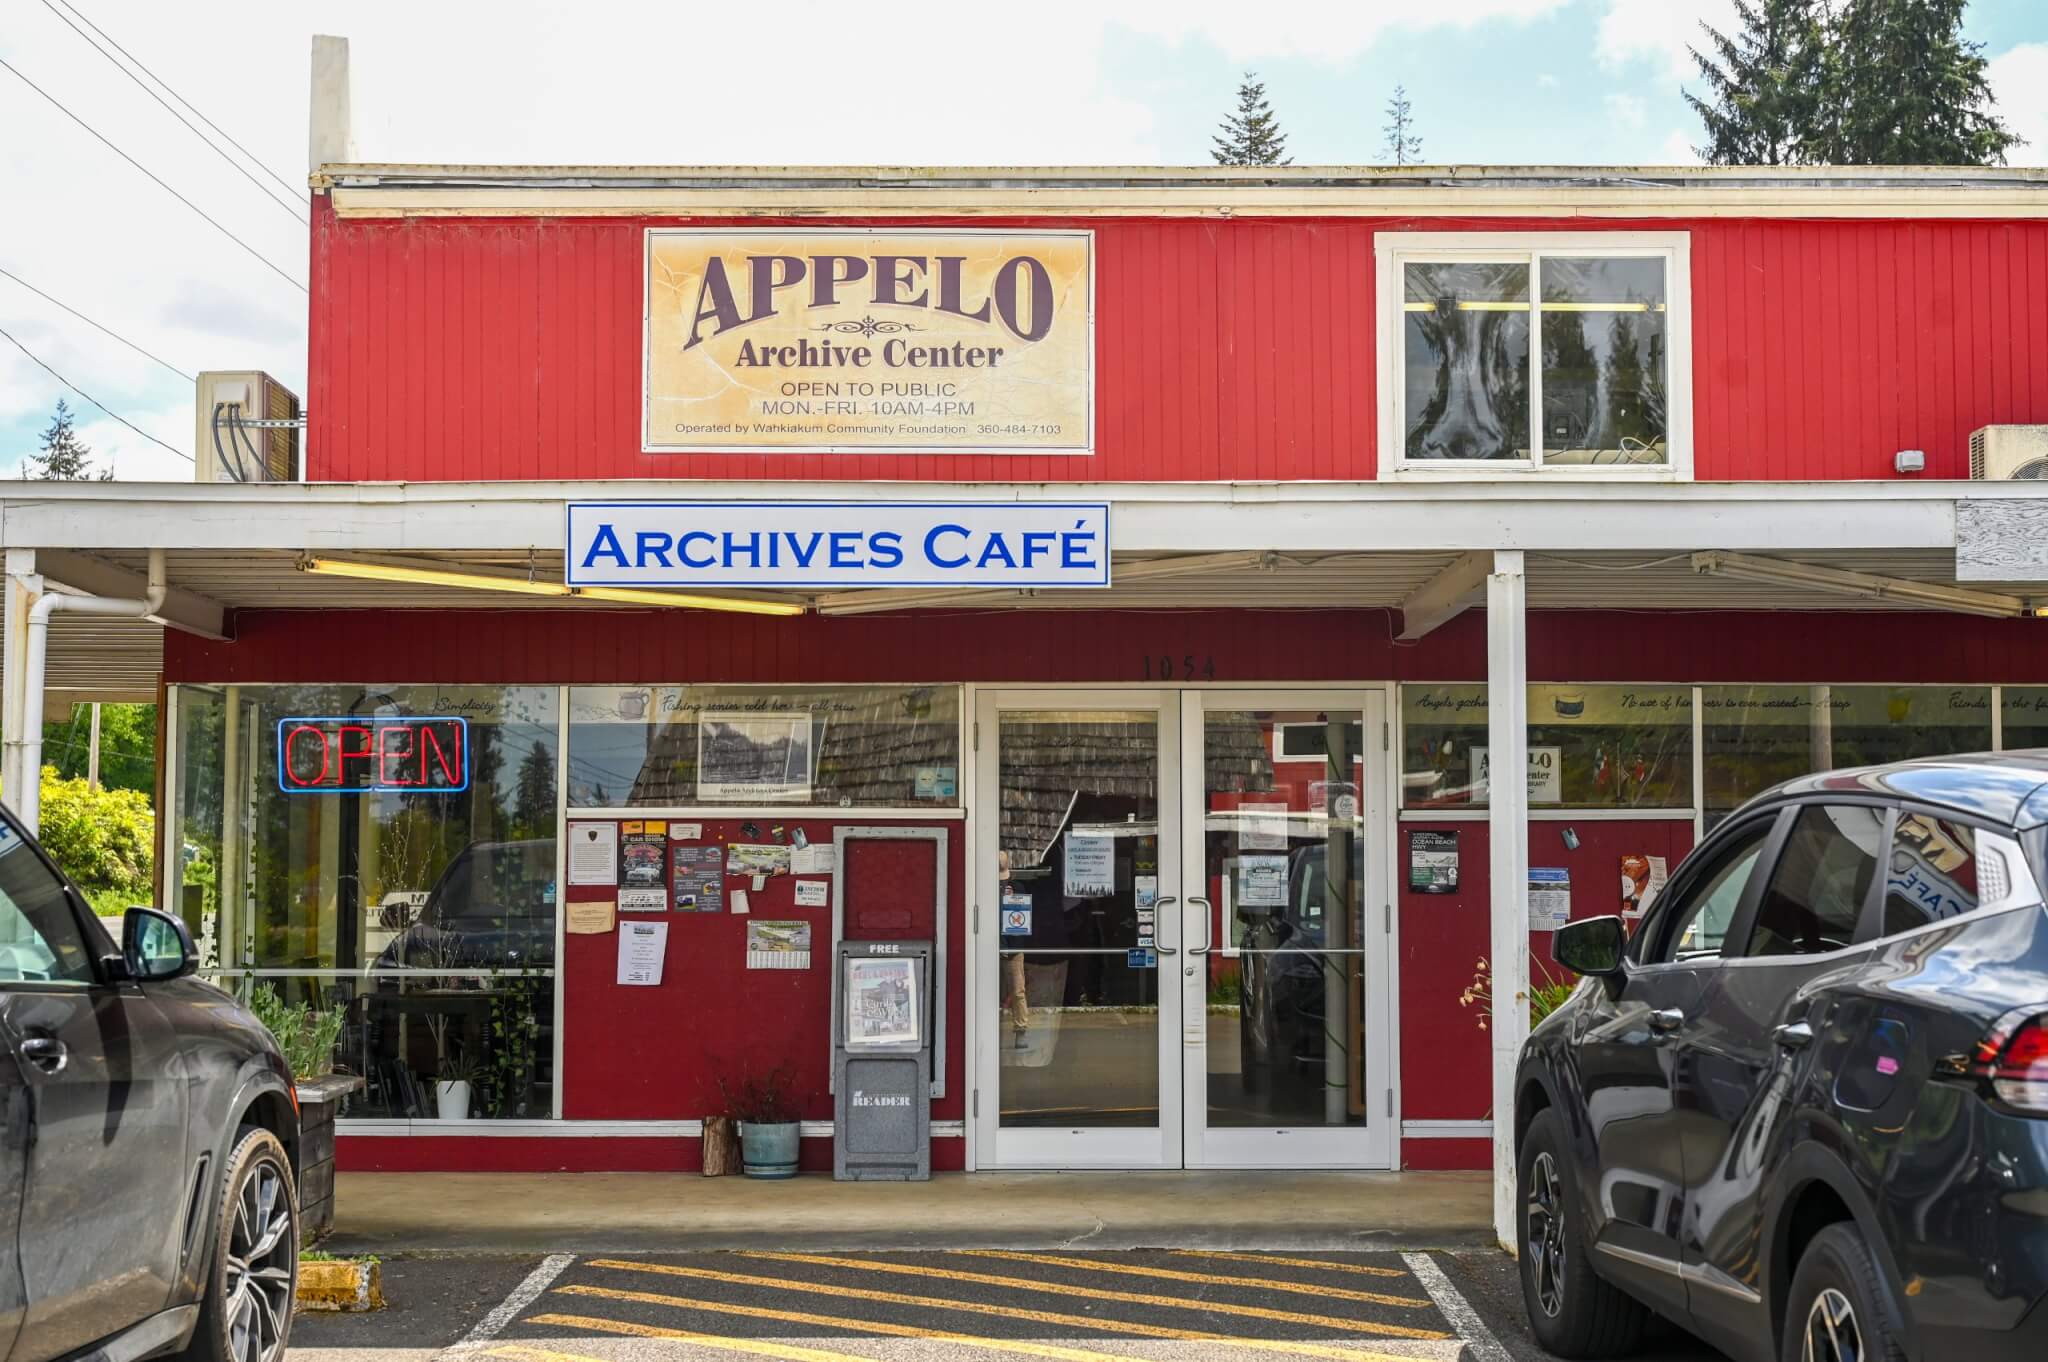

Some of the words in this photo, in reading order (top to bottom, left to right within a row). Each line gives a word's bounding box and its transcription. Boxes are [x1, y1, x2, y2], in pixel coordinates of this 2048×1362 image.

[682, 254, 1055, 352] APPELO
[735, 338, 872, 368] Archive
[882, 339, 1004, 368] Center
[781, 382, 839, 397] OPEN
[846, 382, 874, 397] TO
[881, 382, 957, 397] PUBLIC
[872, 401, 975, 416] 10AM-4PM
[675, 423, 731, 435] Operated
[735, 423, 750, 435] by
[753, 423, 823, 434] Wahkiakum
[827, 424, 894, 436] Community
[899, 424, 966, 435] Foundation
[976, 424, 1062, 435] 360-484-7103
[581, 523, 904, 570] ARCHIVES
[922, 519, 1097, 570] CAFÉ
[1143, 655, 1217, 681] 1054
[1622, 694, 1637, 709] No
[286, 721, 461, 786] OPEN
[869, 944, 900, 954] FREE
[852, 1092, 911, 1107] READER
